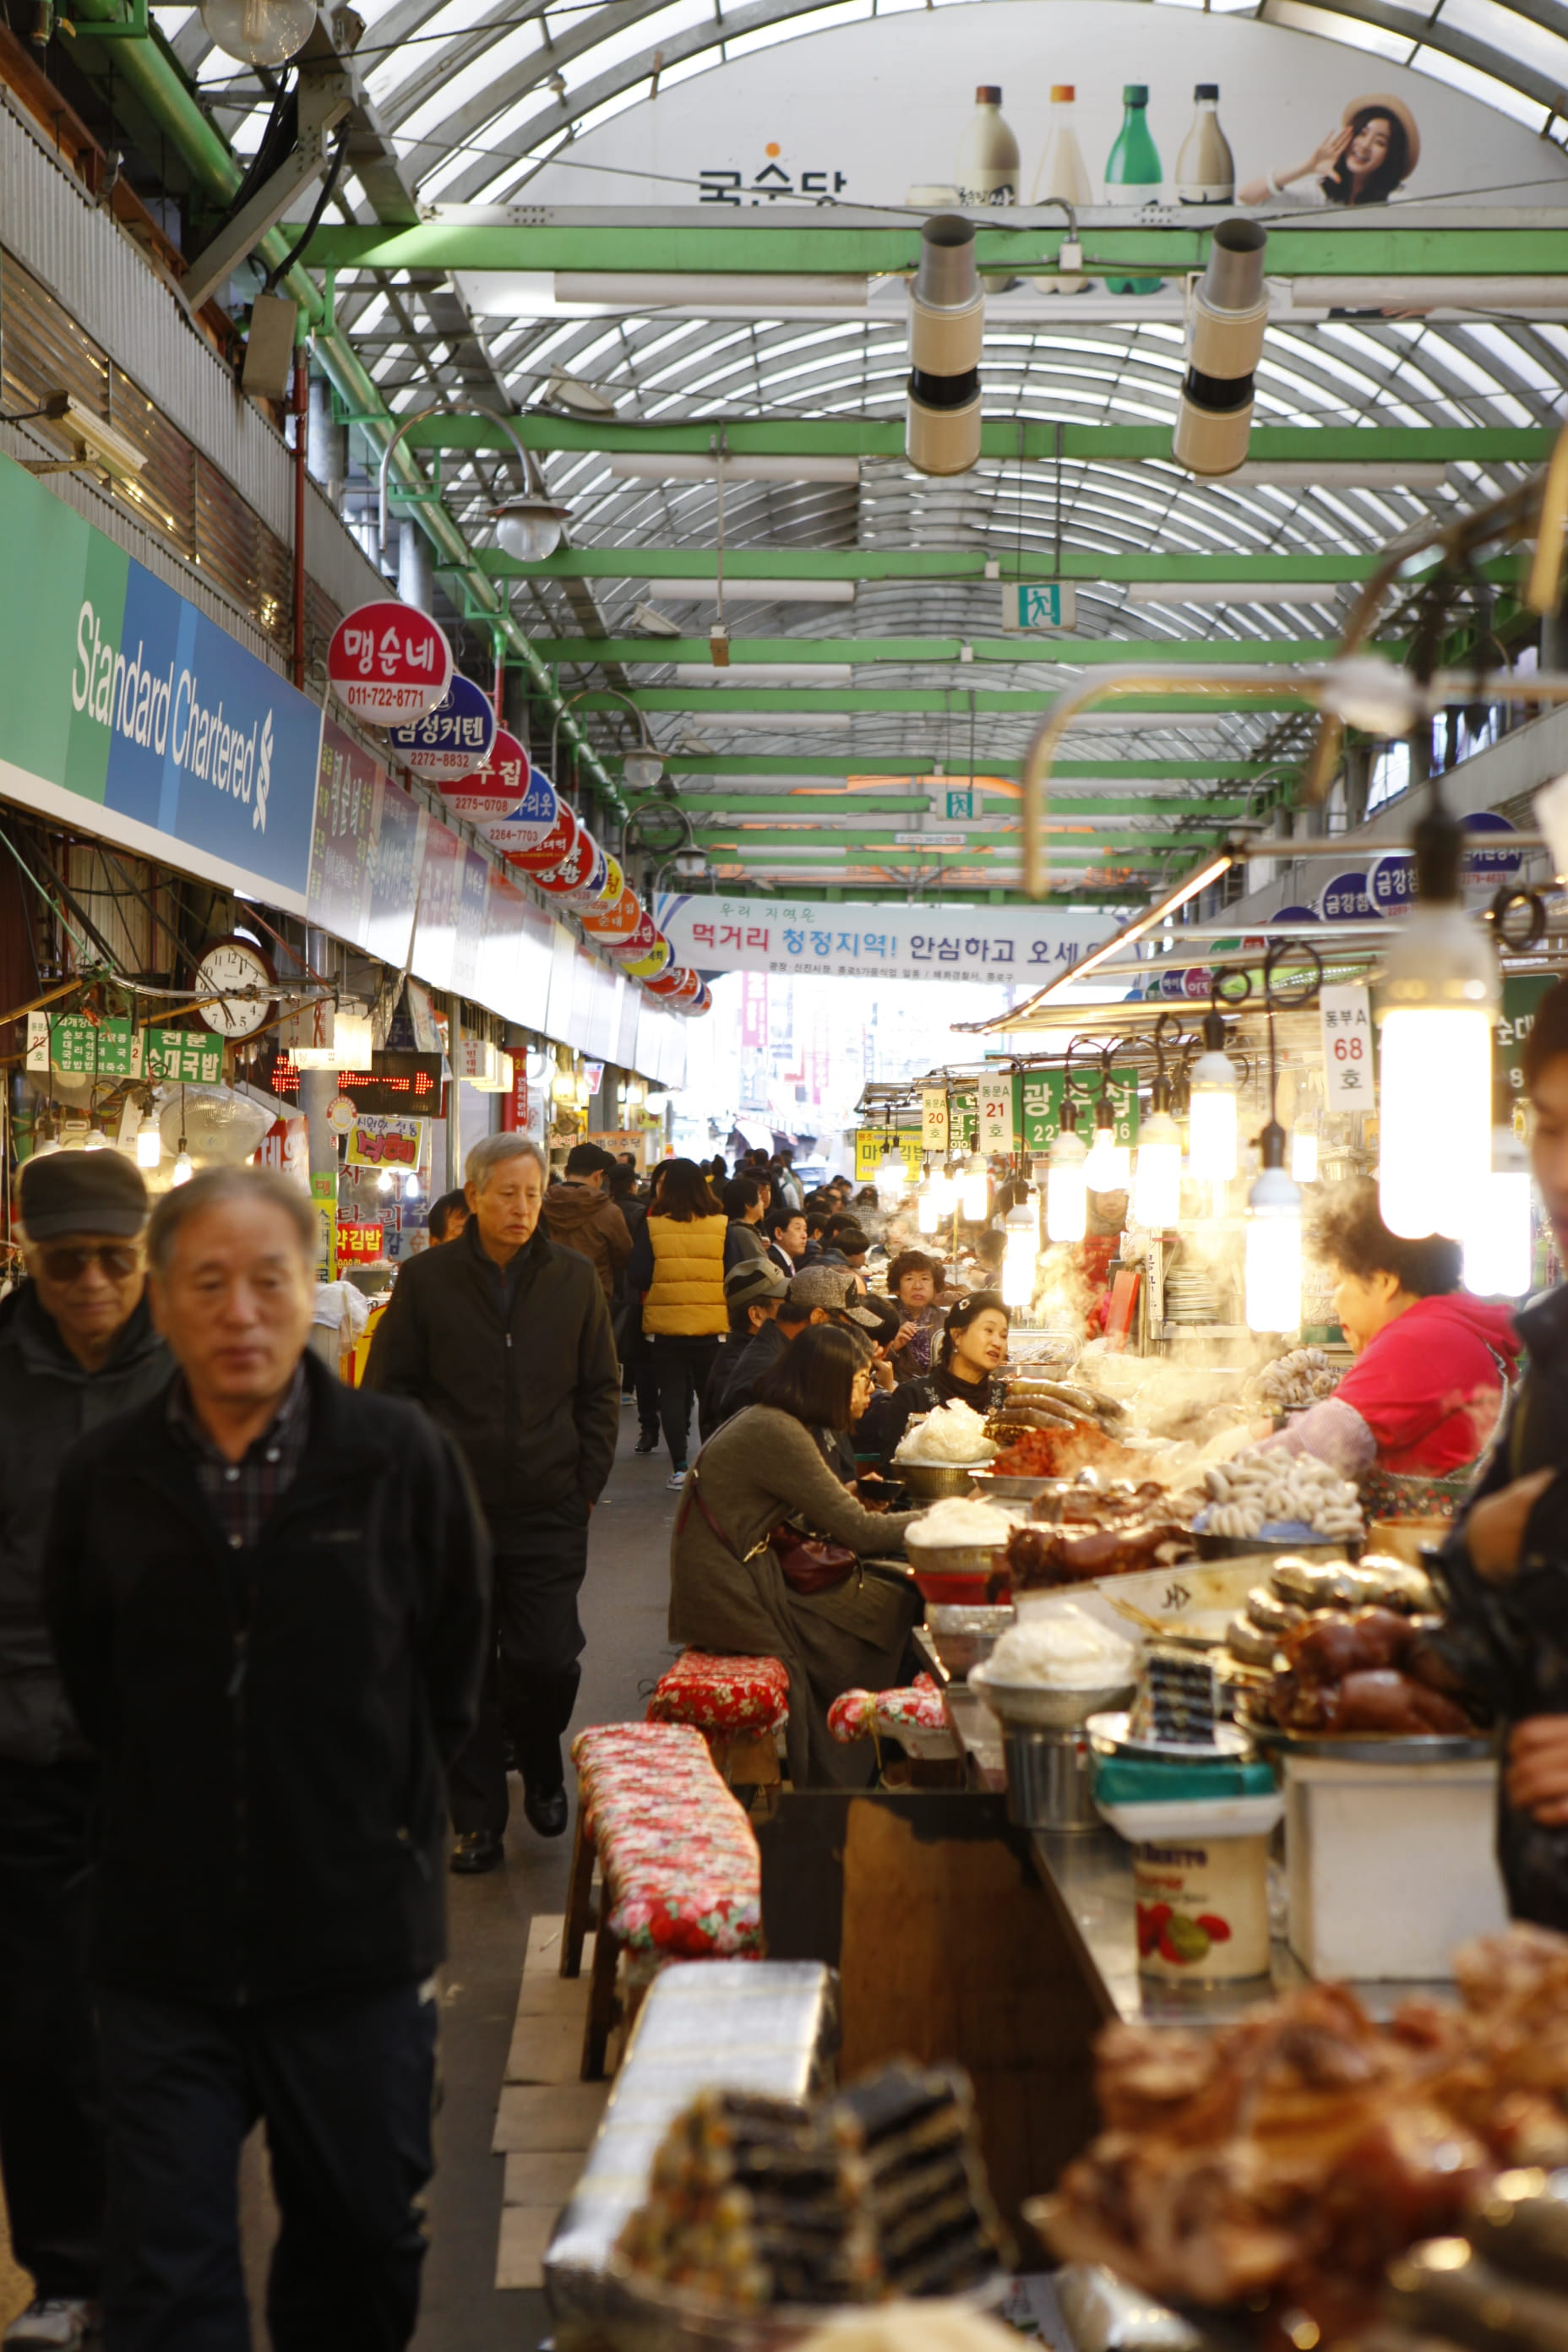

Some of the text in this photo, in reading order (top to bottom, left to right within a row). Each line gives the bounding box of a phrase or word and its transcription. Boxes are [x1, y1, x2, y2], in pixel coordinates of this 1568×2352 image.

[700, 163, 847, 207] 국순당
[343, 626, 435, 677] 맹순네
[72, 600, 257, 803] Standard Chartered
[347, 686, 424, 708] 011-722-8771
[395, 715, 485, 747] 삼성커텐
[720, 902, 750, 918] 우리
[692, 923, 770, 952] 먹거리
[782, 928, 898, 958] 청정지역!
[910, 935, 1015, 963] 안심하고
[1324, 1009, 1368, 1028] 동부A
[160, 1032, 208, 1048] 전문
[1333, 1037, 1364, 1061] 68
[144, 1048, 220, 1082] 순대국밥
[1339, 1069, 1364, 1090] 호
[982, 1085, 1010, 1098] 동문A
[928, 1112, 945, 1124] 20
[986, 1102, 1004, 1118] 21
[930, 1128, 941, 1139] 호
[988, 1123, 1004, 1138] 호
